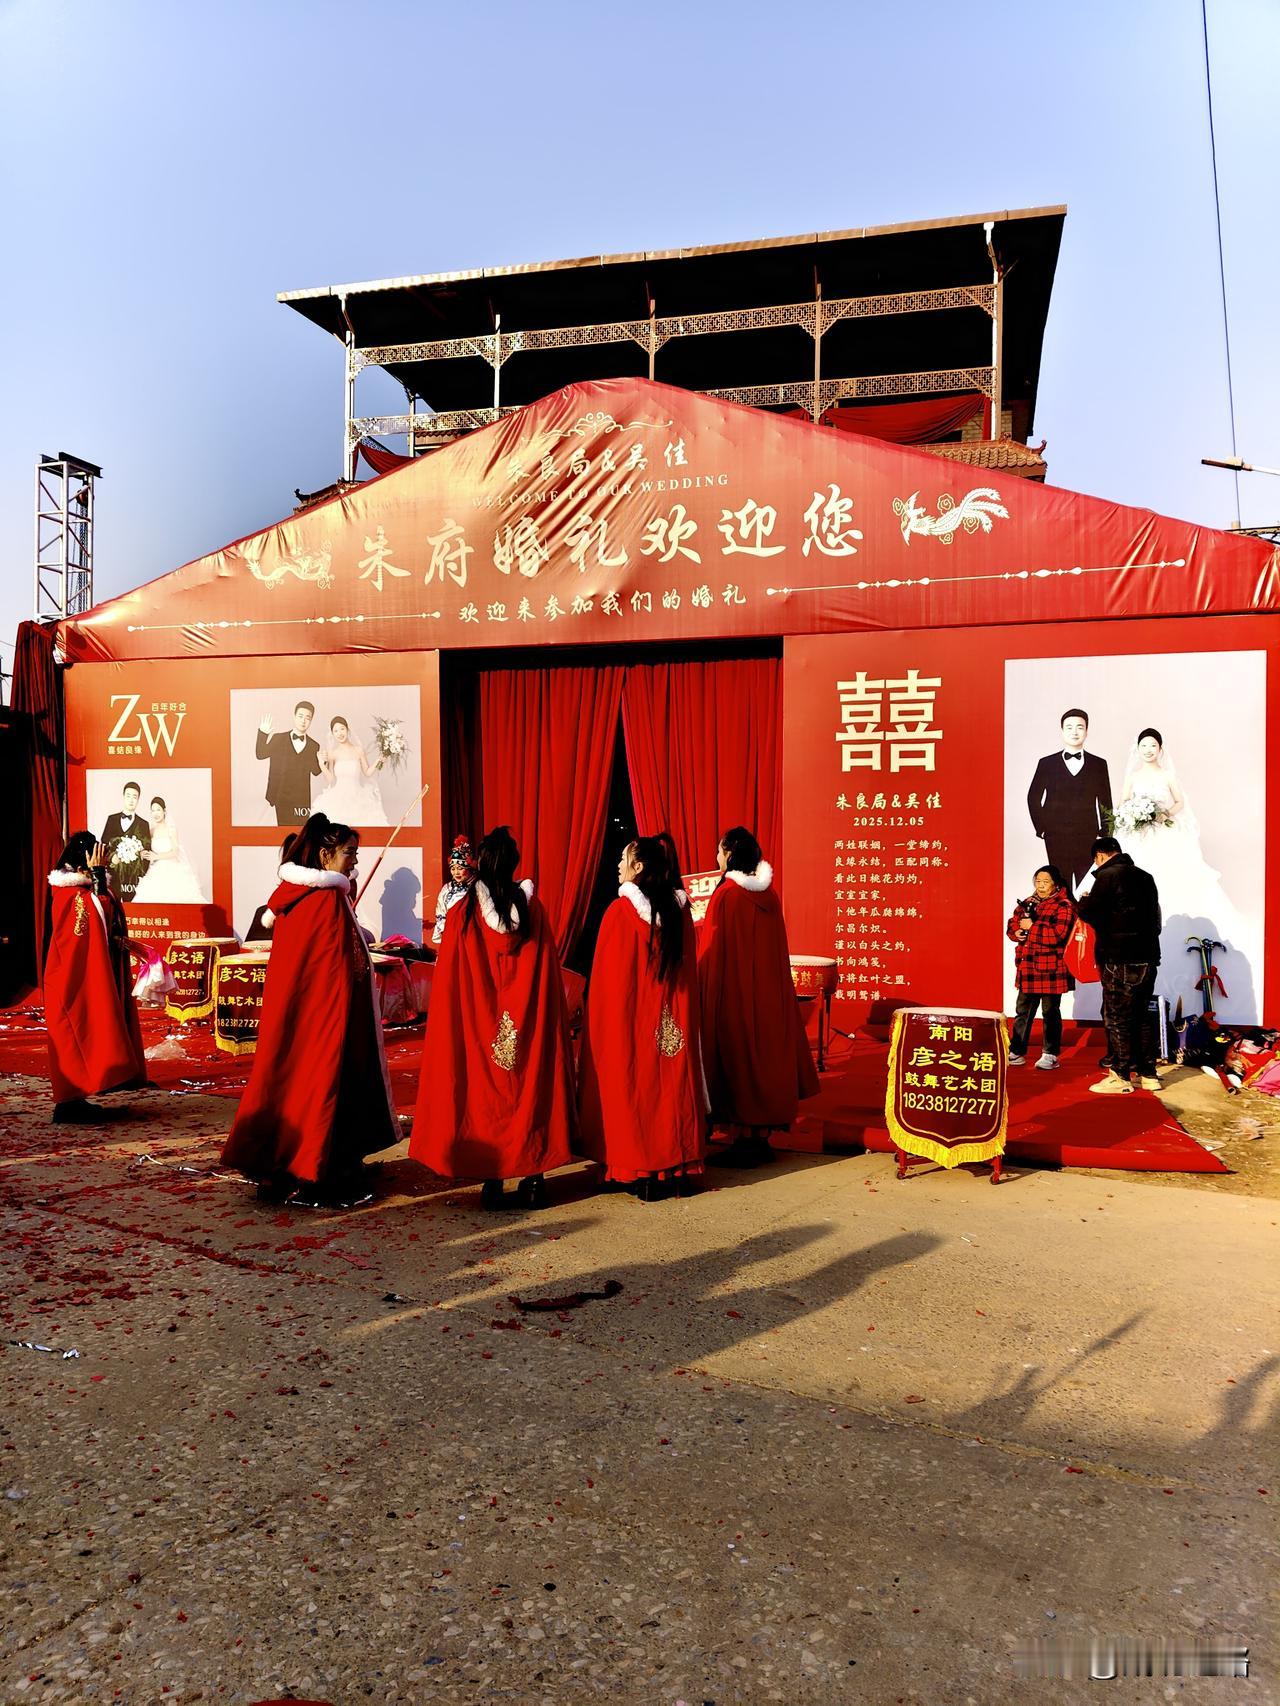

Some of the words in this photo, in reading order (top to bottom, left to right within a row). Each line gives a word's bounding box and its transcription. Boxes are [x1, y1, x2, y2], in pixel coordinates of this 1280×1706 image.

[568, 487, 588, 501] TO
[596, 481, 634, 499] OUR
[640, 473, 730, 493] WEDDING
[358, 483, 864, 592] 朱府婚礼欢迎您
[458, 583, 748, 625] 欢迎来参加我们的婚礼
[152, 702, 186, 712] 百年好合
[853, 816, 925, 827] 2025.12.05
[928, 1025, 973, 1042] 南阳
[908, 1047, 997, 1072] 彦之语
[904, 1071, 997, 1094] 鼓舞艺术团
[902, 1092, 997, 1116] 18238127277
